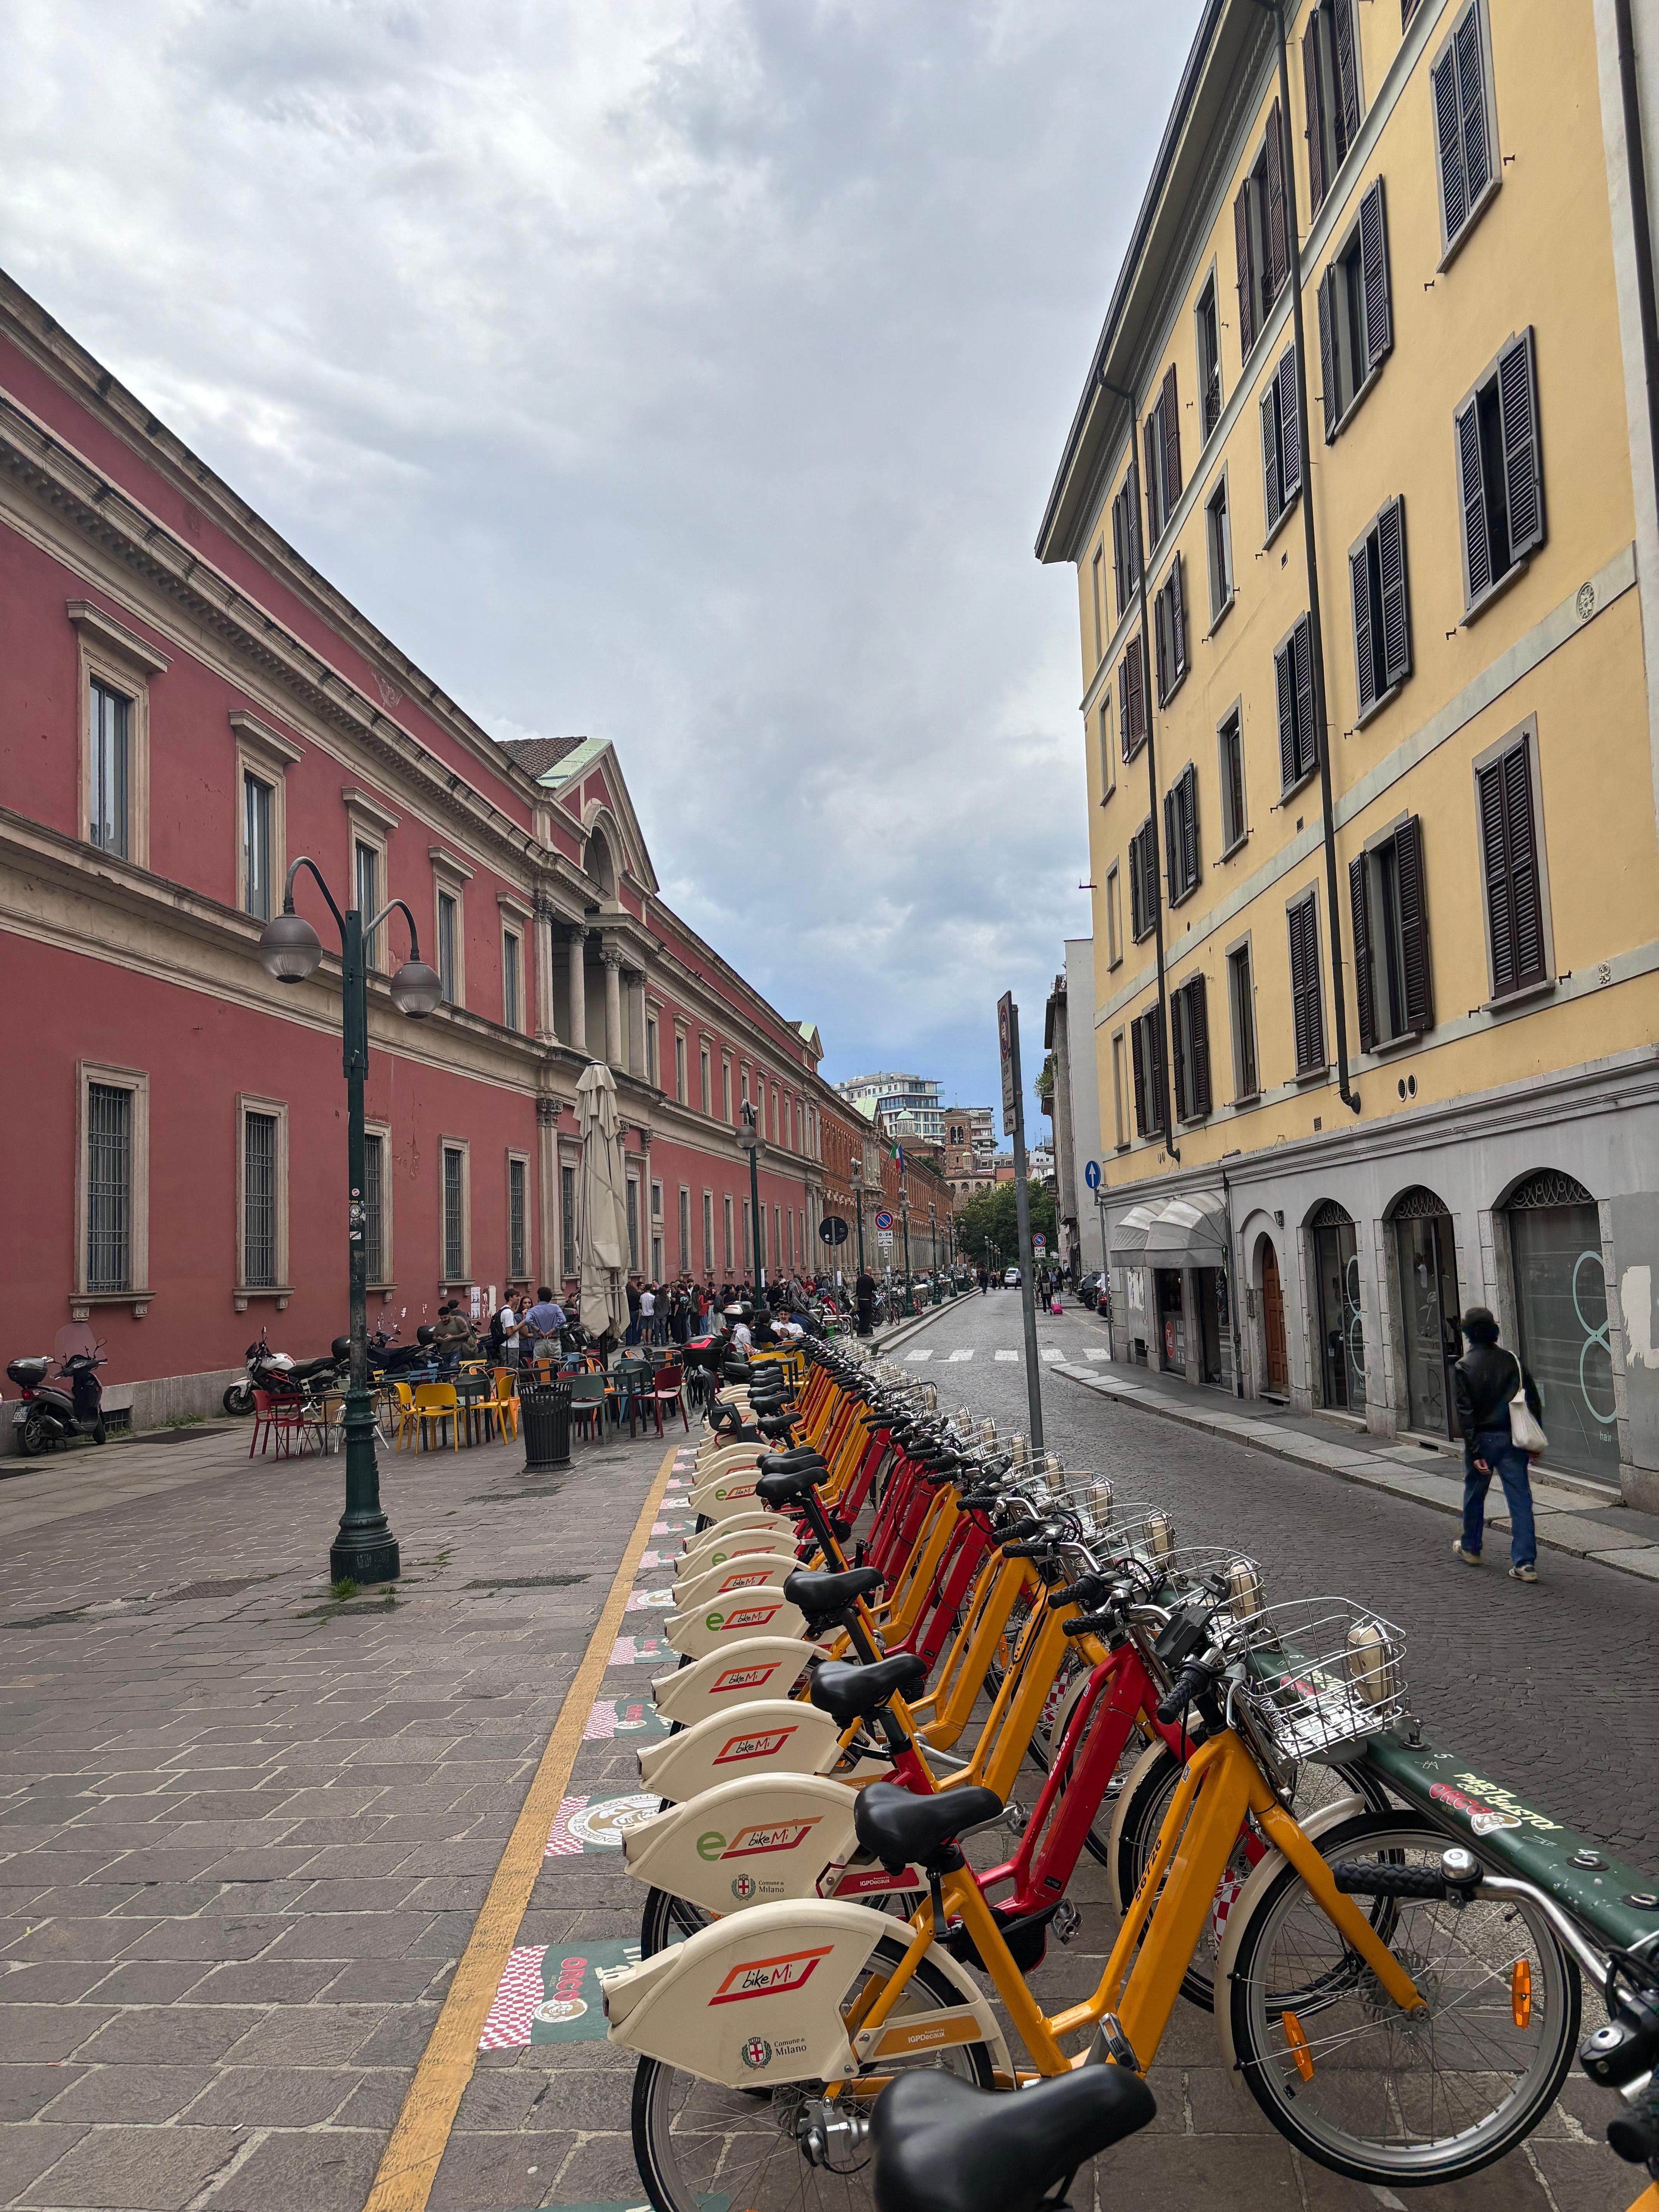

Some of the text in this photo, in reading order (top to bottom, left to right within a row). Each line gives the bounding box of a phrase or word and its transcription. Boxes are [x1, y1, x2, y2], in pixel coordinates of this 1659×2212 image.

[1600, 1431, 1611, 1442] hair
[1429, 1783, 1494, 1815] ORCO
[1135, 1838, 1161, 1902] 56726
[553, 1957, 587, 2001] ORCO
[742, 1964, 793, 1988] bikeMi
[774, 2038, 800, 2047] Comune
[908, 2032, 945, 2043] IGPDecaux
[776, 2044, 807, 2056] Milano
